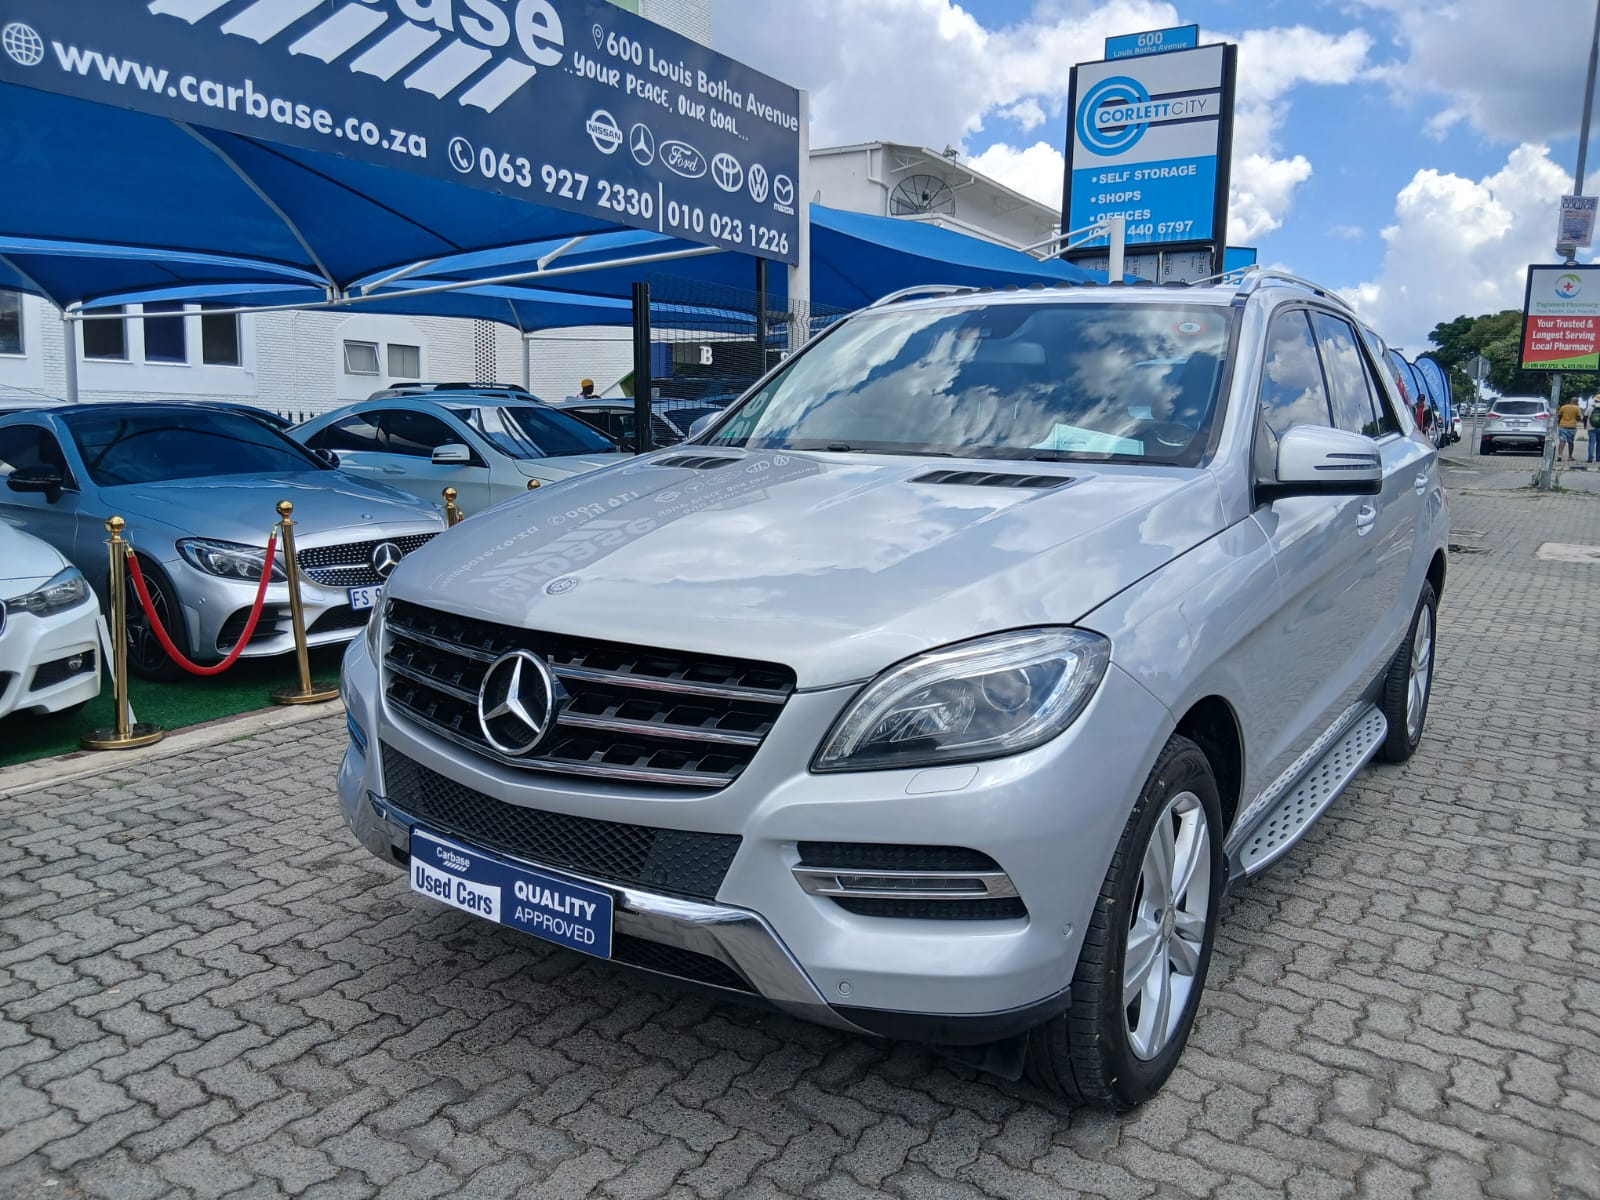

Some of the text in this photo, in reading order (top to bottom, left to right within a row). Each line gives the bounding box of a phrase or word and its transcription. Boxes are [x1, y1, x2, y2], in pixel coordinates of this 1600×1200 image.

[1137, 31, 1163, 47] 600
[1113, 41, 1187, 58] Louis Botha Avenue
[606, 31, 799, 132] 600 Louis Botha Avenue
[52, 41, 428, 158] www.carbase.co.za
[626, 73, 673, 113] PEACE,
[678, 95, 705, 122] OUR
[587, 122, 621, 141] NISSAN
[668, 144, 699, 173] Ford
[1099, 165, 1197, 185] SELF STORAGE
[479, 147, 789, 255] 063 927 2330 010 023 1226
[1098, 190, 1142, 205] SHOPS
[1127, 223, 1153, 236] 440
[1157, 220, 1194, 234] 6797
[1537, 319, 1593, 329] Your Trusted &
[1532, 330, 1596, 341] Longest Serving
[699, 346, 713, 365] B
[1531, 341, 1594, 352] Local Pharmacy
[352, 589, 369, 607] FS
[436, 846, 471, 868] Carbase
[415, 865, 493, 915] Used Cars
[514, 880, 597, 921] QUALITY
[514, 905, 596, 945] APPROVED
